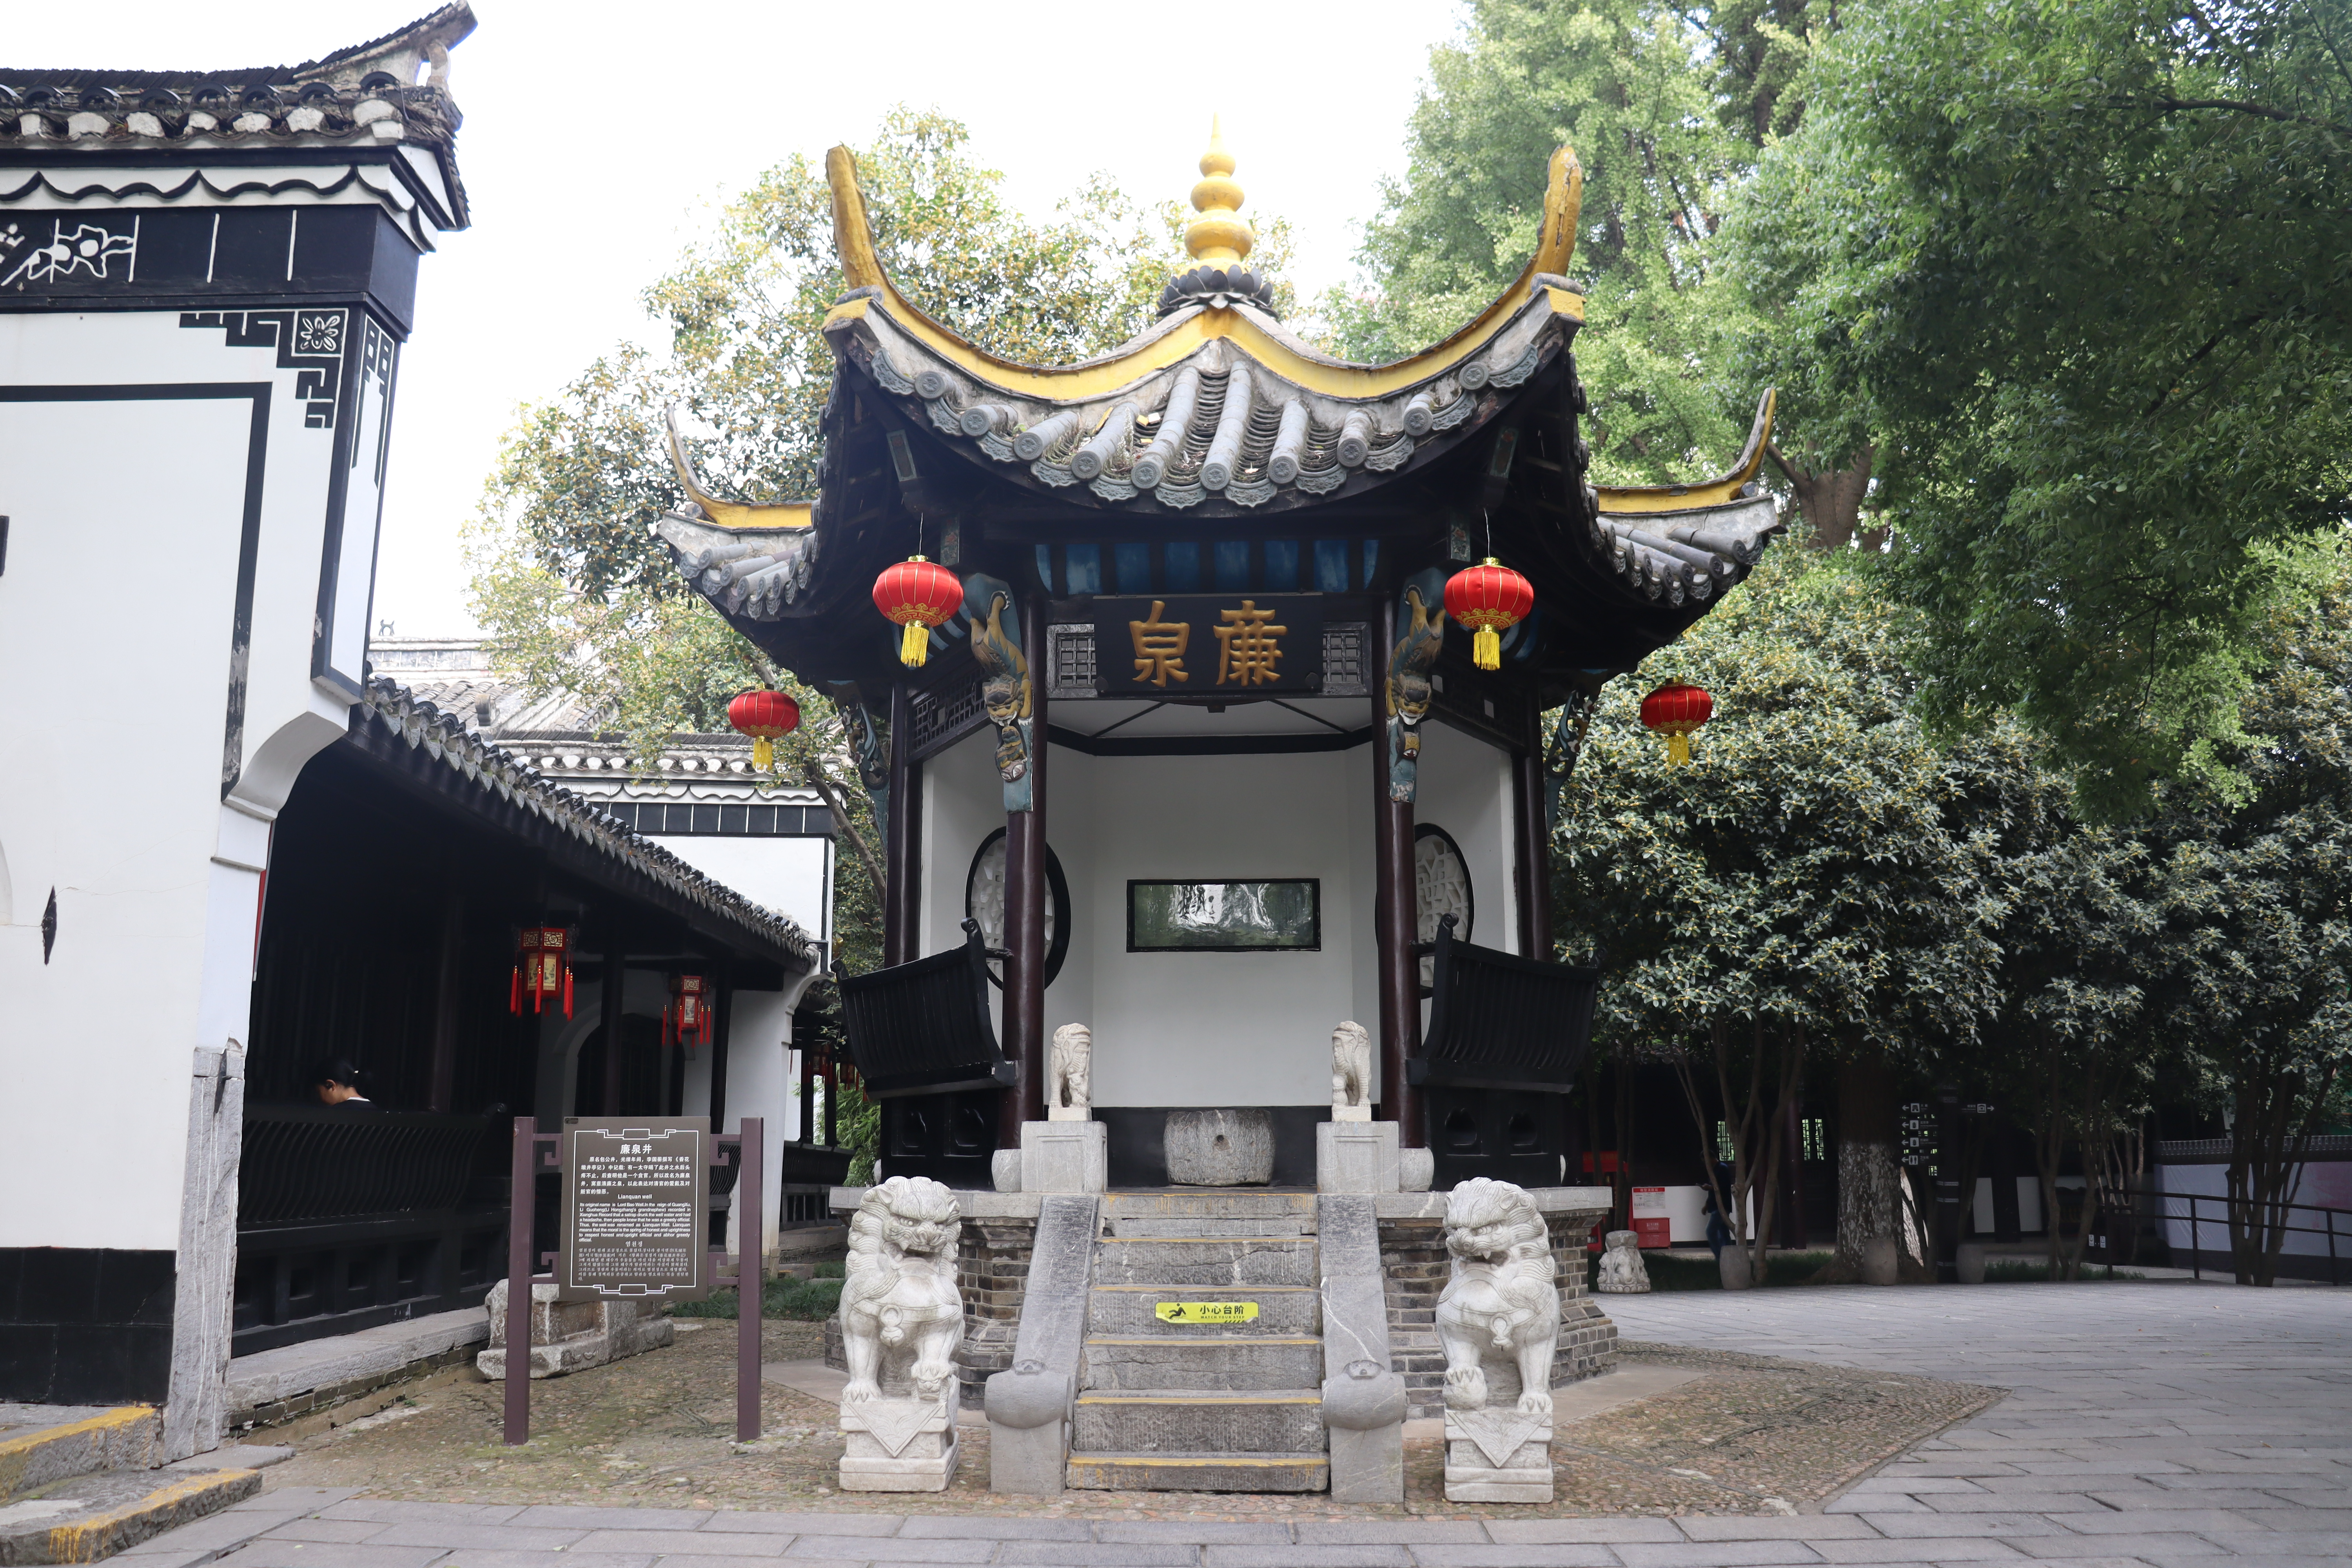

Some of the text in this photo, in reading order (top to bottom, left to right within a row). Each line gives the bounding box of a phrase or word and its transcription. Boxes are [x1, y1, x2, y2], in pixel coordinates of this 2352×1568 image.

[620, 1144, 652, 1154] 廉泉井
[1200, 1305, 1244, 1315] 小心台阶
